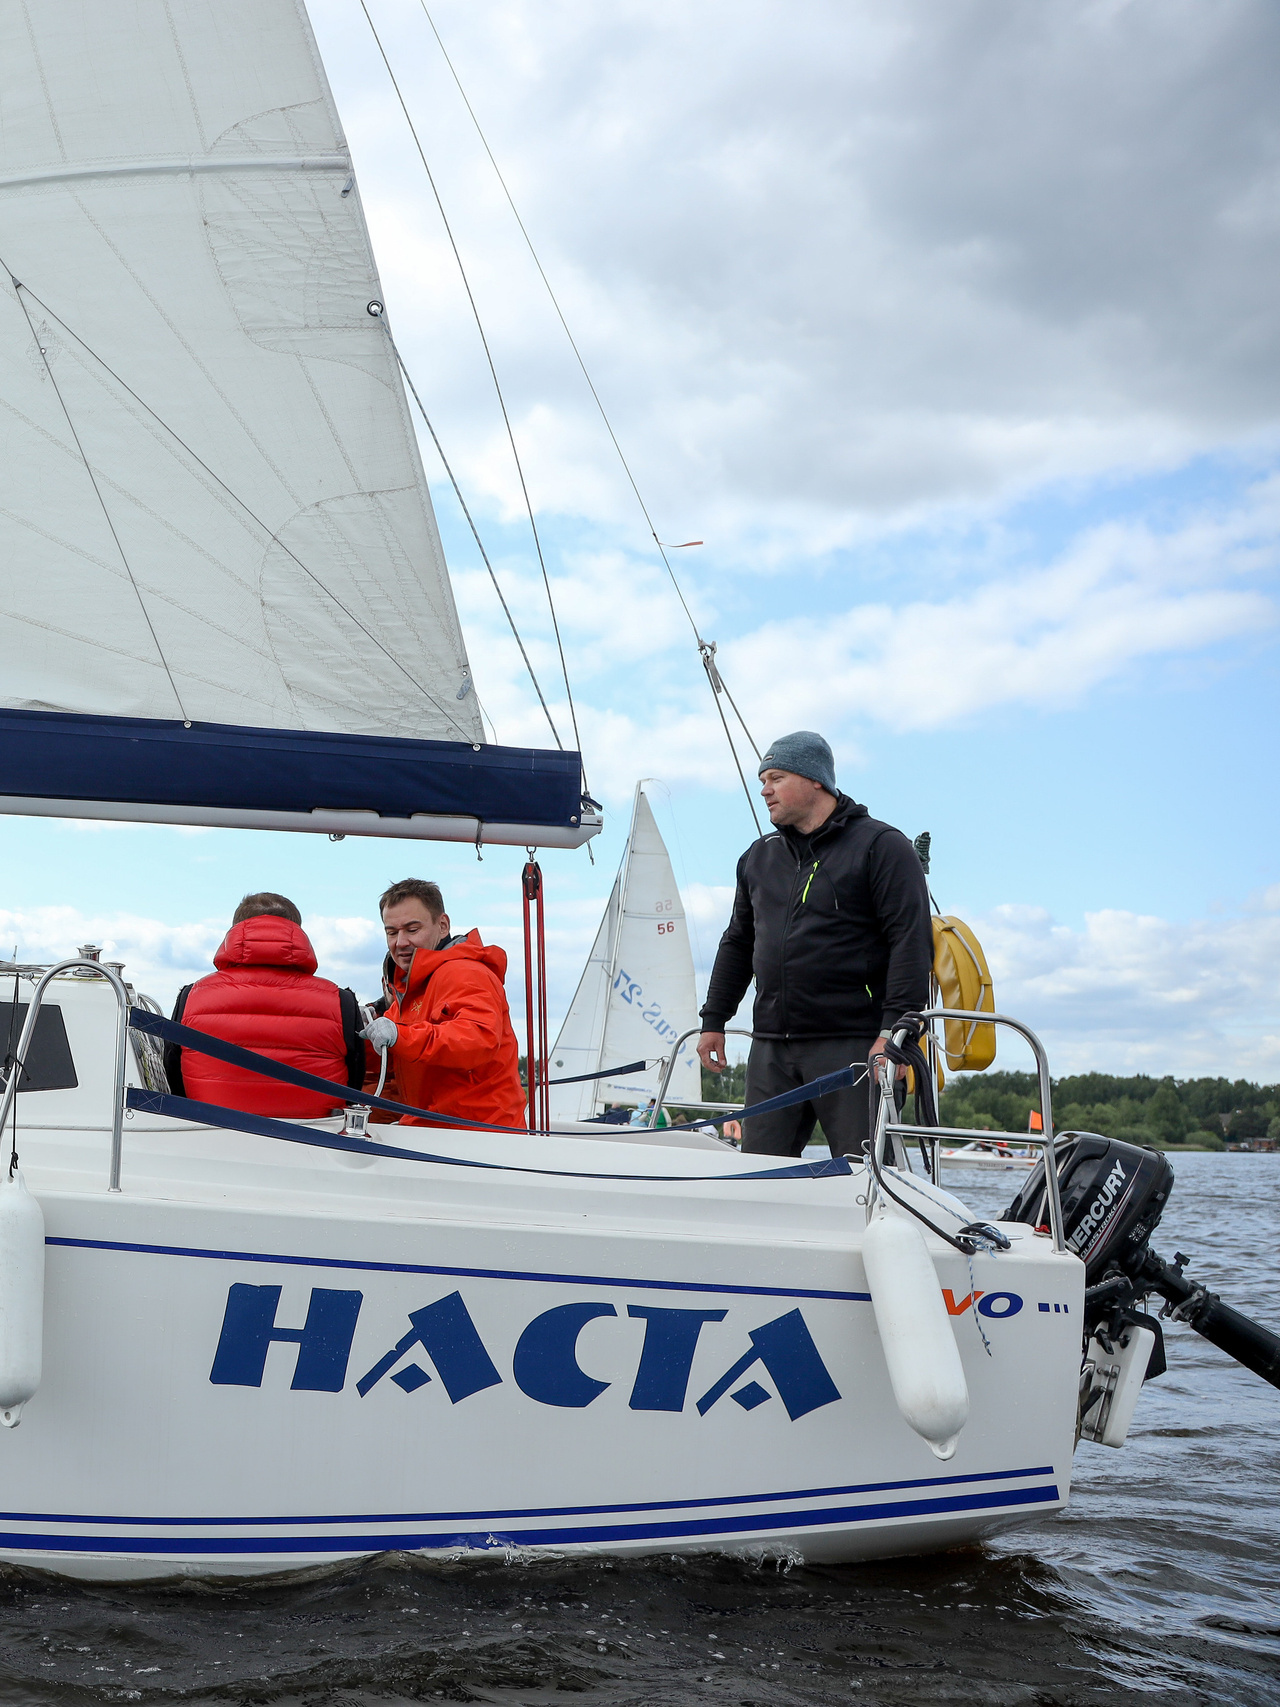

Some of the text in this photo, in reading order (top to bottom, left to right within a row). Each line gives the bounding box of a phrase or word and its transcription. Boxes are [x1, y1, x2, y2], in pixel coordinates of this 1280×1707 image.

[657, 921, 675, 936] 56
[1080, 1203, 1119, 1259] OURSTROKE
[209, 1282, 842, 1421] НАСТА
